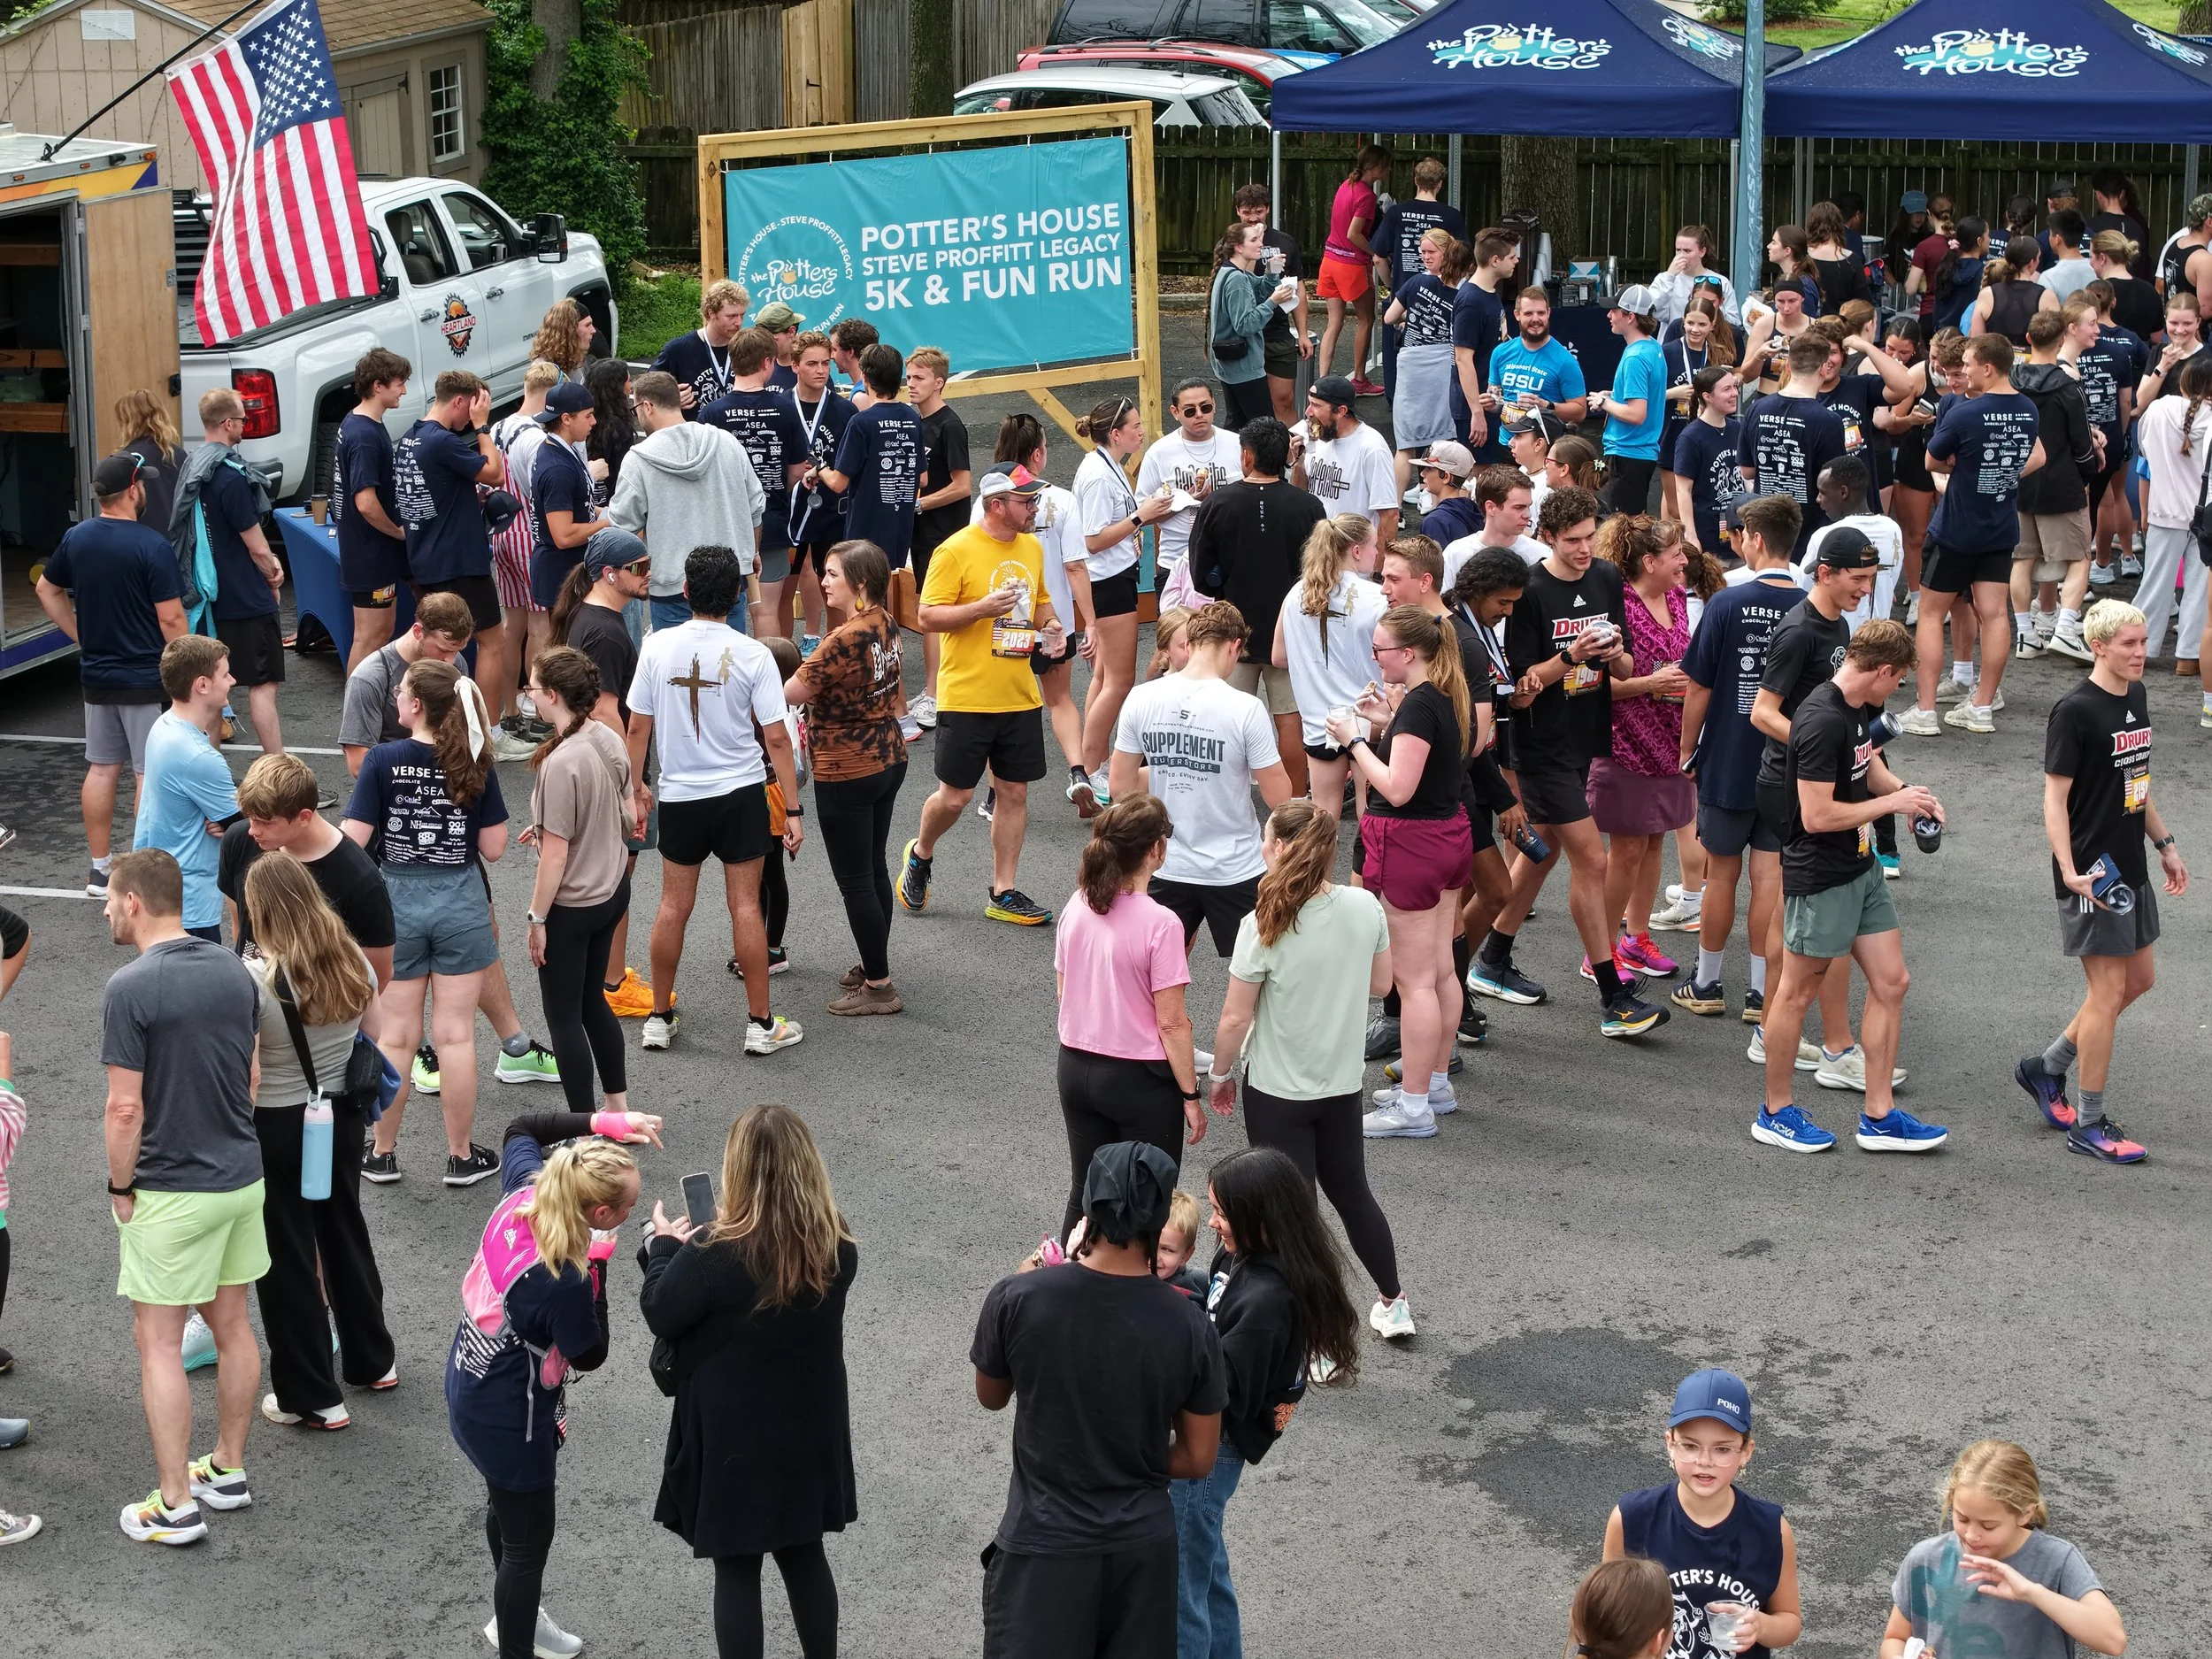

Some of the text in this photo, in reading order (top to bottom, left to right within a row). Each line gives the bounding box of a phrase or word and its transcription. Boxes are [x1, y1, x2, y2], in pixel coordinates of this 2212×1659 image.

[1426, 37, 1462, 50] the
[1893, 44, 1932, 58] the
[1432, 49, 1601, 70] House
[1902, 54, 2079, 78] House
[861, 203, 1120, 252] POTTER'S HOUSE
[738, 247, 753, 286] OTTER'S
[749, 222, 778, 249] HOUSE
[780, 215, 807, 227] STEVE
[808, 217, 842, 244] PROFFITT
[839, 243, 853, 280] LEGACY
[862, 232, 1121, 277] STEVE PROFFITT LEGACY
[751, 272, 769, 283] the
[864, 256, 1122, 311] 5K & FUN RUN
[757, 280, 835, 303] House
[1419, 286, 1441, 303] VERSE
[813, 303, 845, 333] FUN RUN
[1427, 303, 1442, 316] ASEA
[441, 316, 476, 334] HEARTLAND
[1531, 365, 1548, 377] State
[1502, 372, 1545, 392] BSU
[725, 409, 756, 418] VERSE
[1759, 414, 1786, 425] VERSE
[1838, 403, 1861, 419] HOUSE
[818, 425, 835, 443] OUSE
[1773, 429, 1791, 438] ASEA
[1741, 606, 1781, 619] VERSE
[1001, 631, 1032, 649] 2023
[671, 667, 687, 676] RUN
[1142, 731, 1225, 762] SUPPLEMENT
[1154, 757, 1213, 771] SUERSTORE
[2114, 754, 2135, 768] CROSS
[391, 765, 431, 779] VERSE
[414, 785, 445, 796] ASEA
[1717, 1397, 1740, 1415] POHO
[1670, 1569, 1761, 1612] TER'S HOUS
